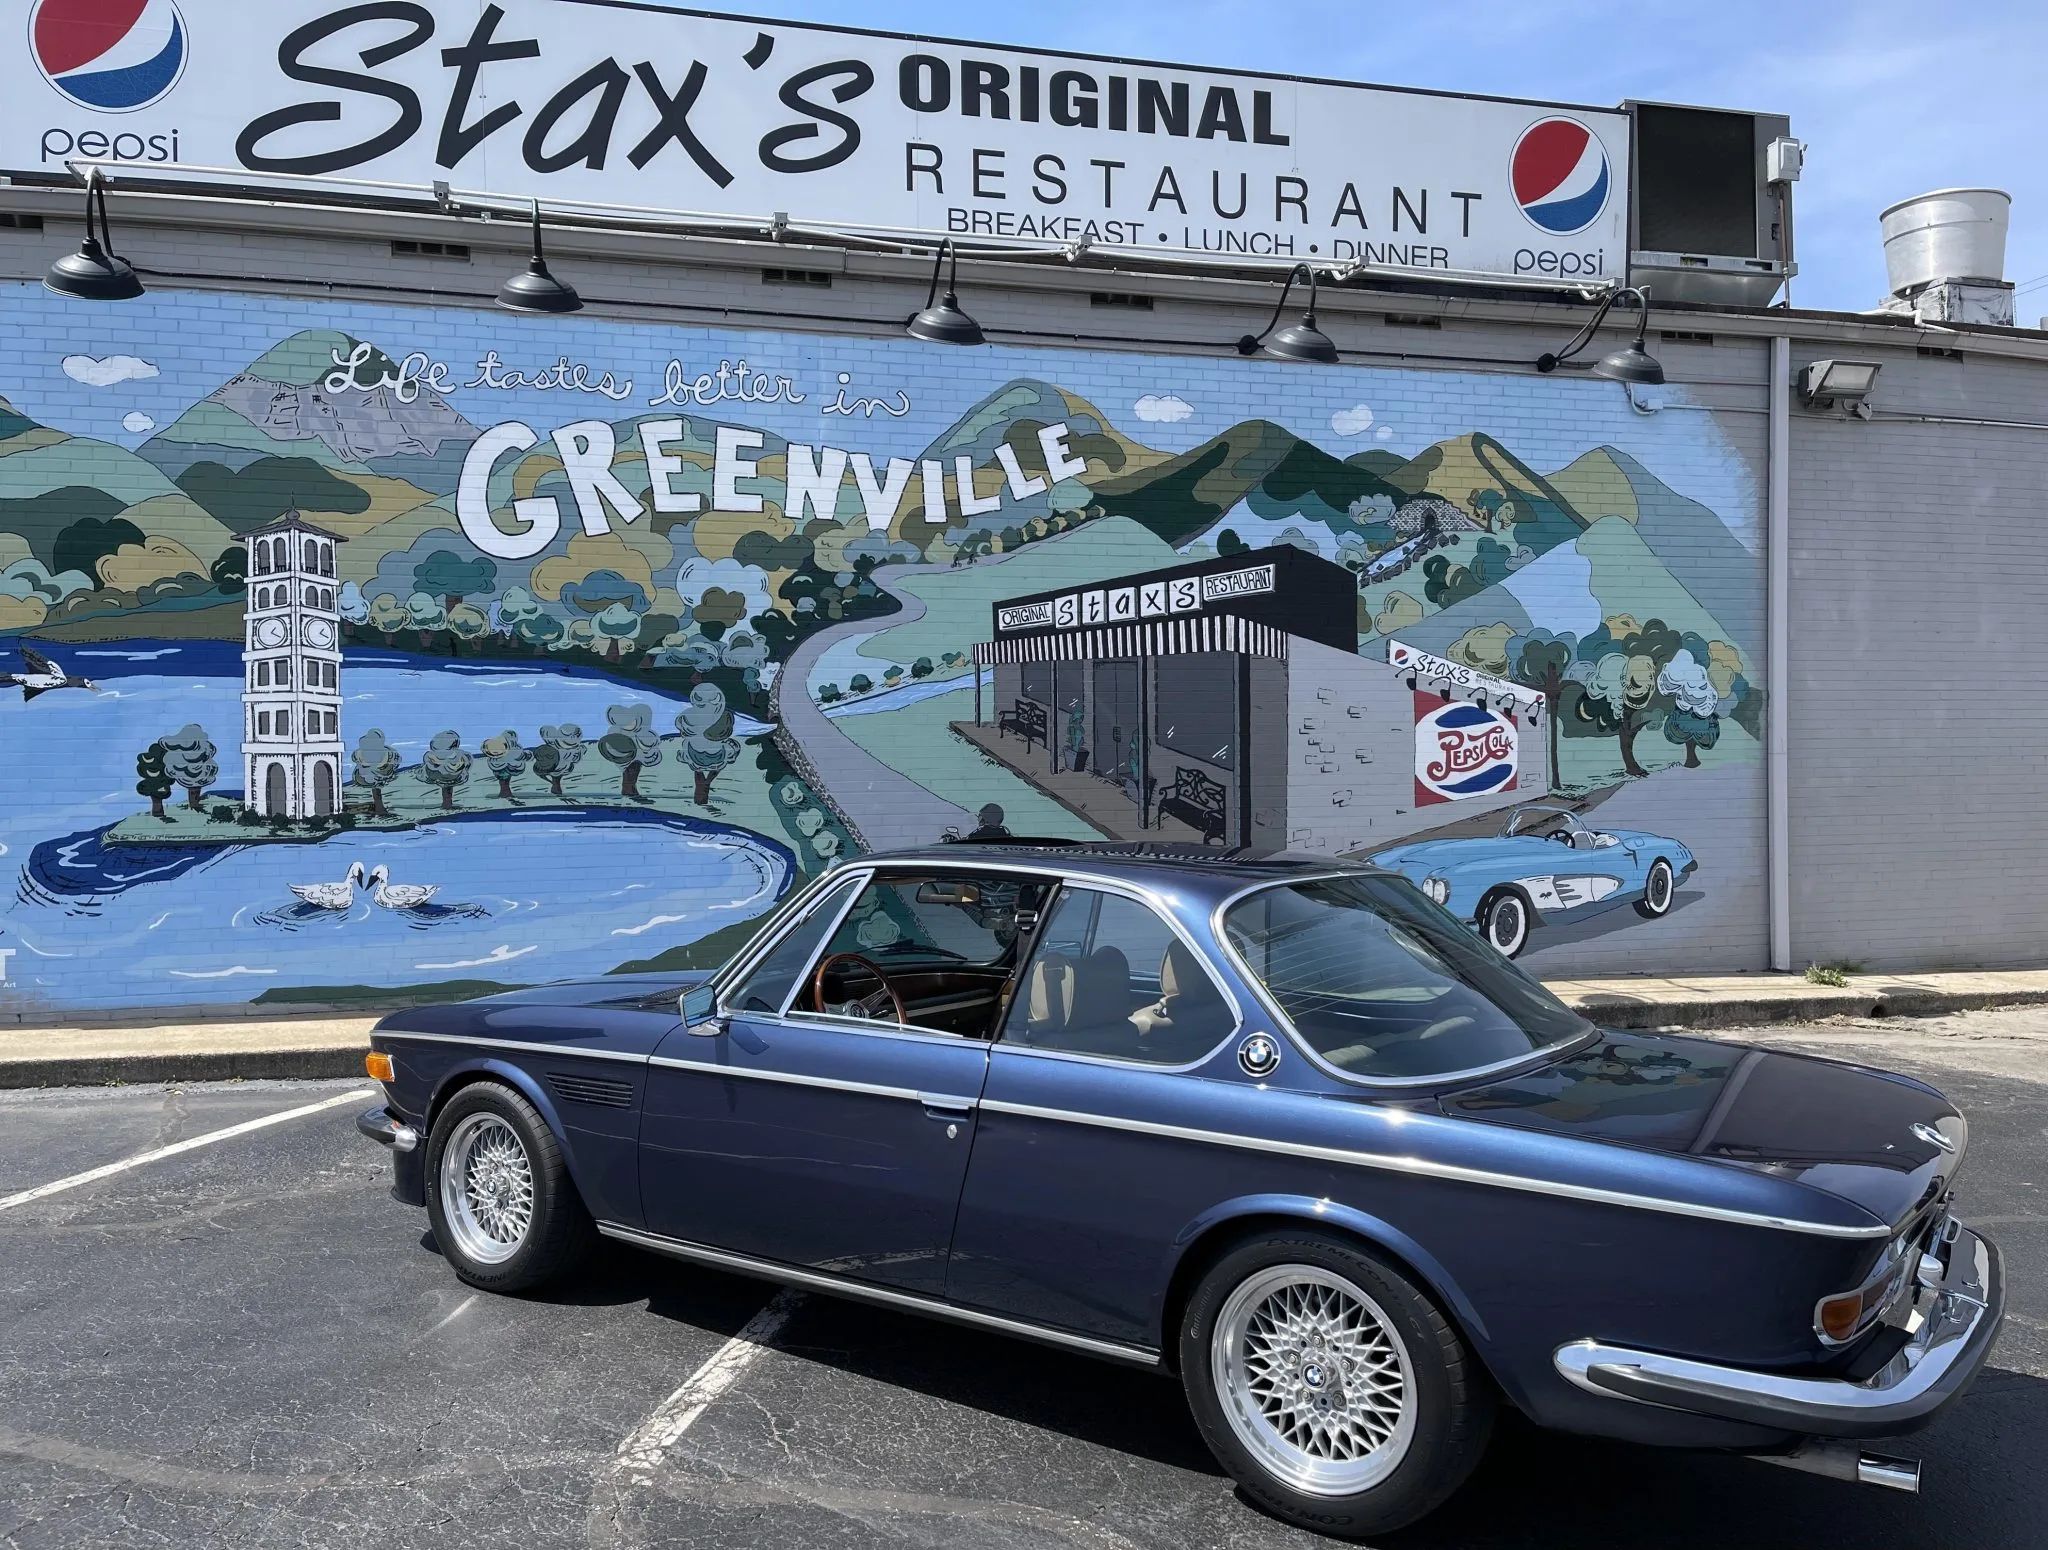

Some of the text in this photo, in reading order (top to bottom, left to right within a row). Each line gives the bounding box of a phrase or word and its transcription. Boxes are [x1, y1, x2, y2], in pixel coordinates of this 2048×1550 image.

[235, 0, 875, 190] Stax's
[898, 54, 1290, 147] ORIGINAL
[41, 128, 180, 165] pepsi
[905, 142, 1482, 238] RESTAURANT
[948, 207, 1449, 269] BREAKFAST LUNCH DINNER
[1514, 248, 1604, 280] pepsi
[324, 342, 910, 417] Life tastes better in
[456, 417, 1088, 559] GREENVILLE
[1002, 603, 1051, 625] ORIGINAL
[1206, 568, 1272, 593] RESTAURANT
[1411, 654, 1471, 684] Stax's
